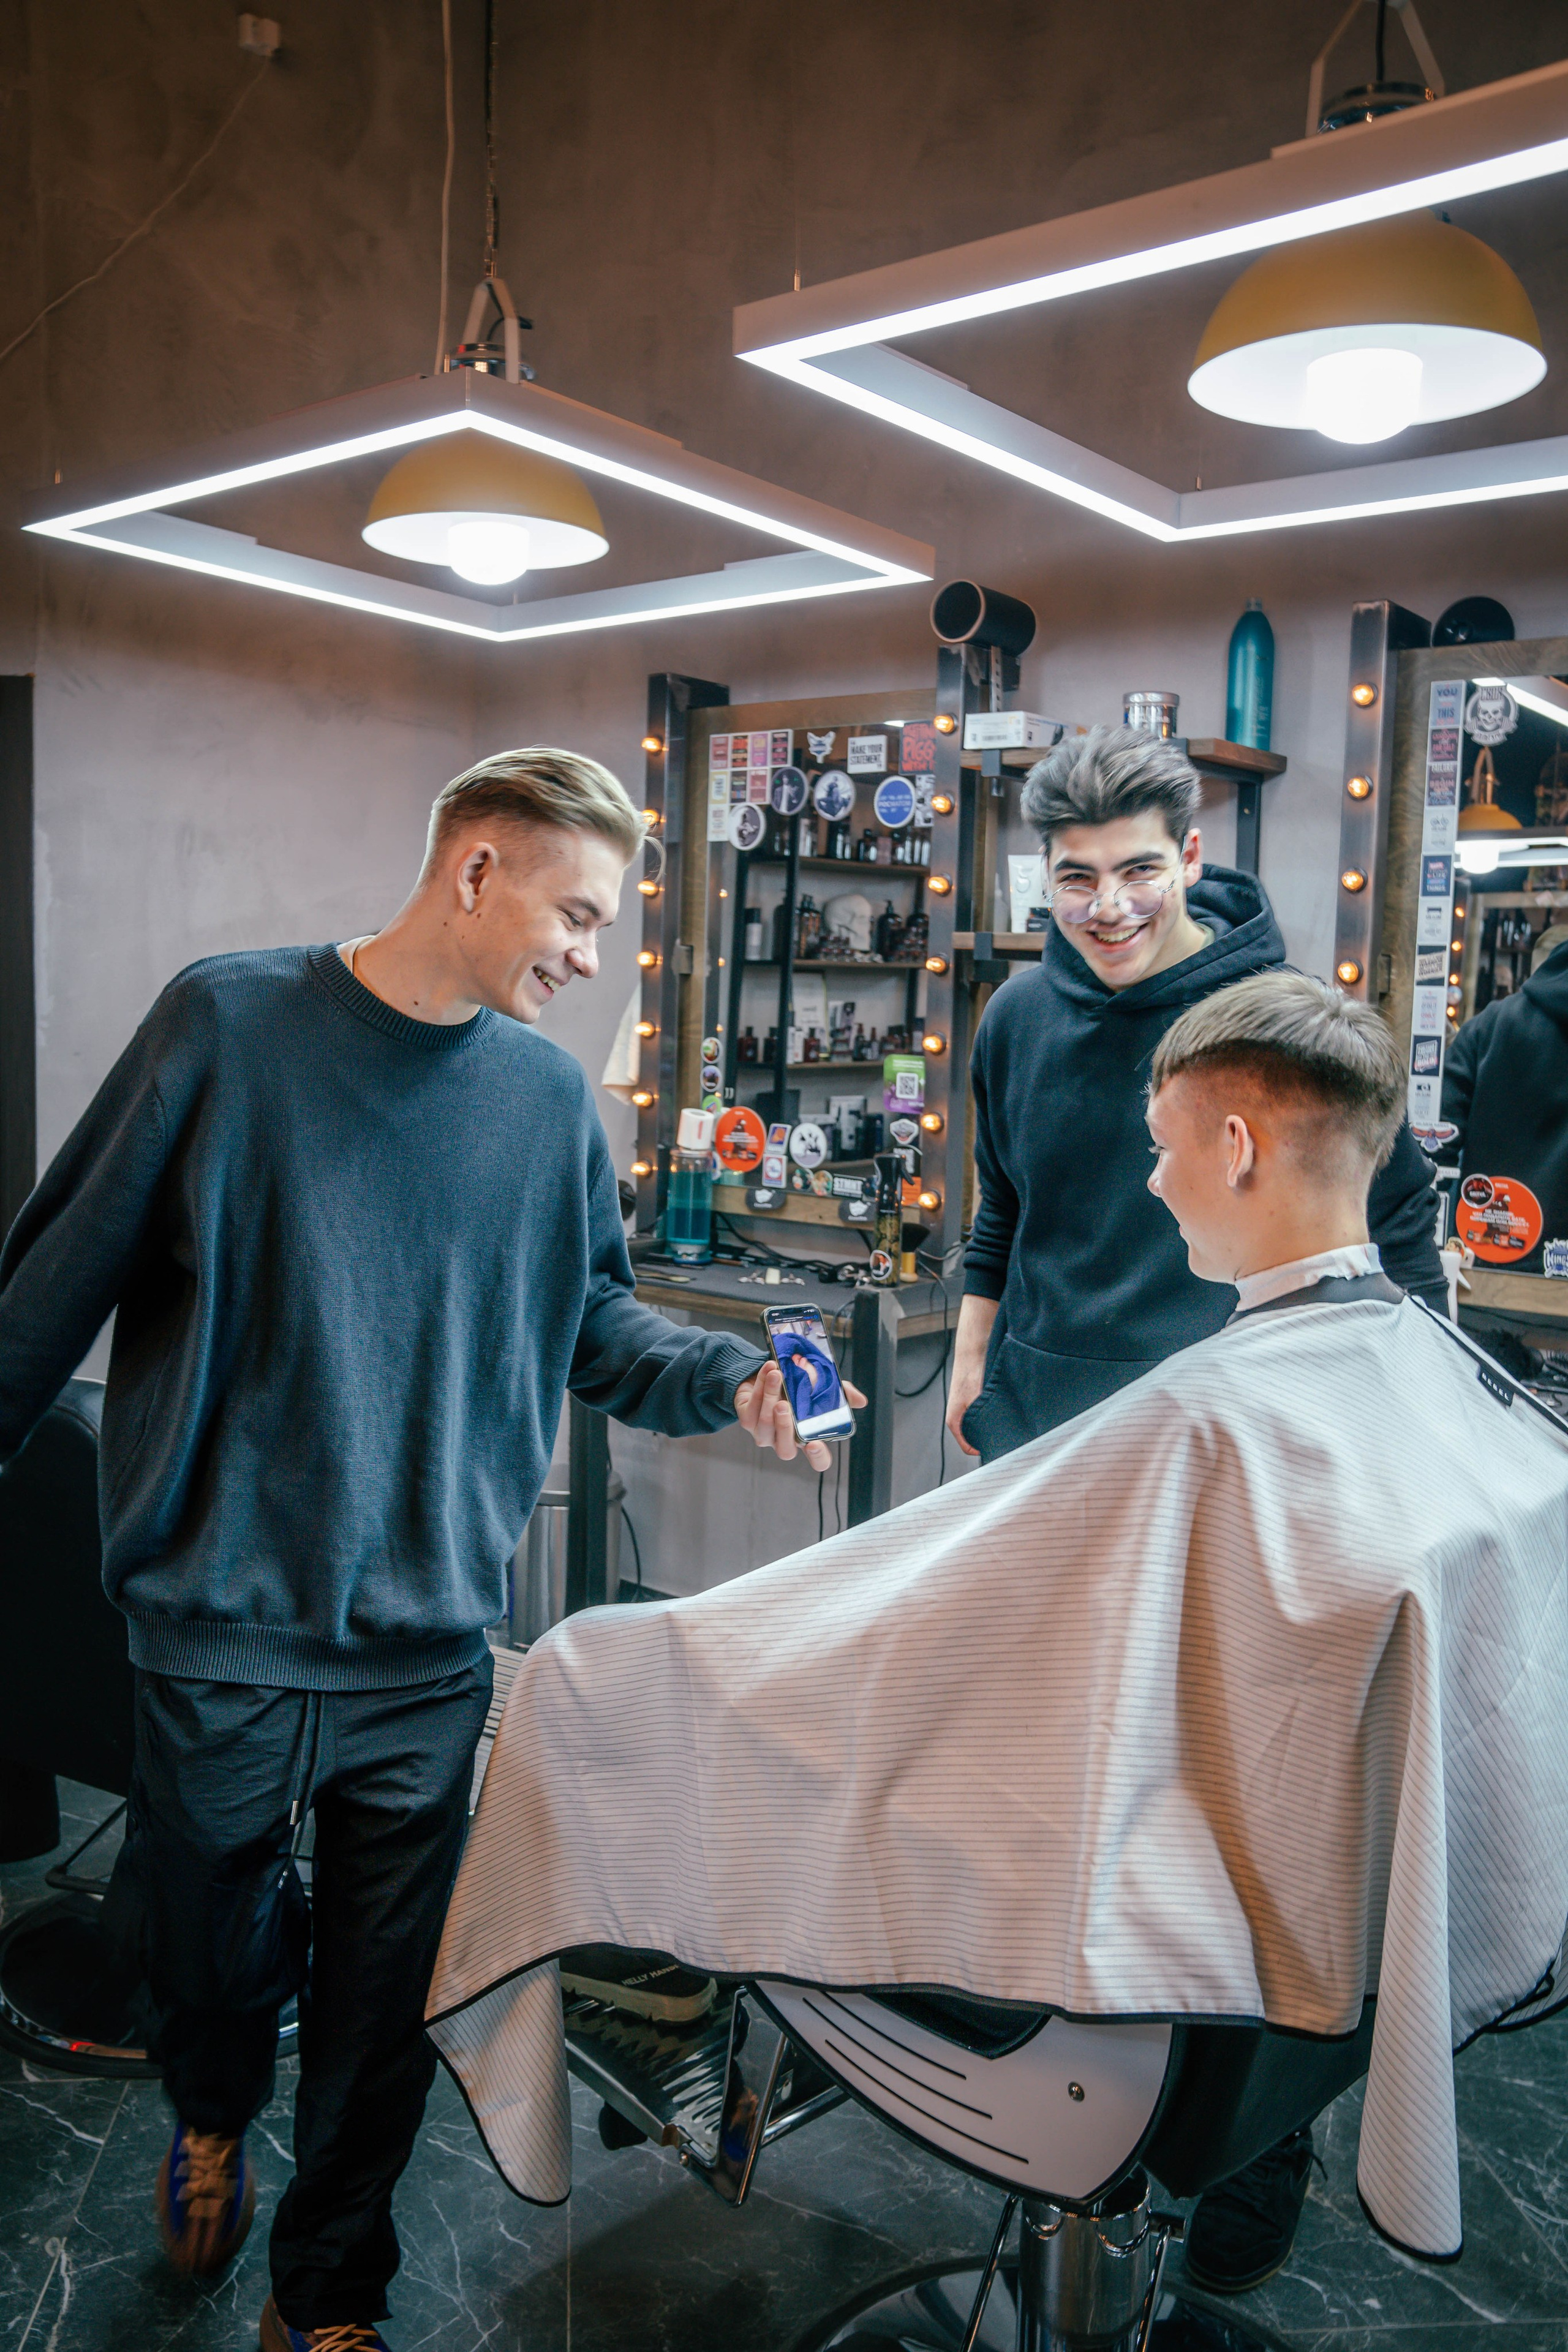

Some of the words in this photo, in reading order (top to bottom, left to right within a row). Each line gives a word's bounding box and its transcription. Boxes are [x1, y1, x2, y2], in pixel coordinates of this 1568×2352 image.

[1437, 688, 1457, 697] YOU
[850, 745, 866, 754] MAKE
[867, 744, 883, 753] YOUR
[1482, 1372, 1510, 1401] REBEL
[622, 1973, 649, 1986] HELLY
